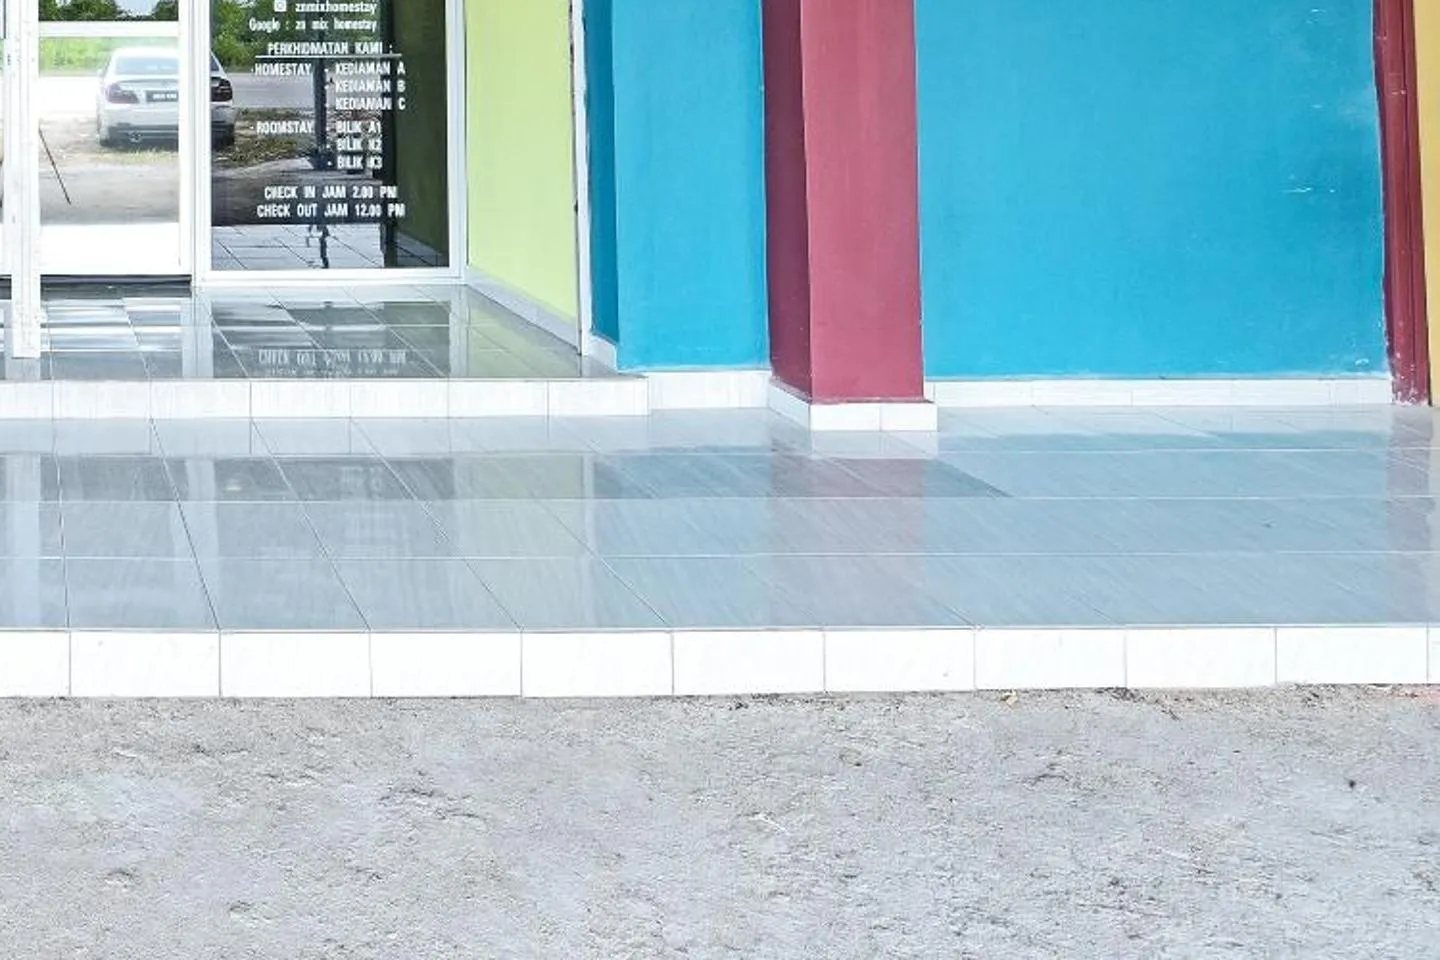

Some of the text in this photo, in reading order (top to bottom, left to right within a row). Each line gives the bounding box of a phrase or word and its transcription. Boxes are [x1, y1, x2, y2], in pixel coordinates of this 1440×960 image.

[248, 17, 281, 33] Google
[334, 17, 378, 33] homestay
[267, 41, 349, 55] PERKHIDMATAN
[355, 41, 383, 54] KAMI
[254, 61, 406, 76] HOMESTAY KEDIAMAN A
[335, 79, 406, 93] KEDIAMAN B
[335, 97, 406, 110] KEDIAMAN C
[256, 121, 382, 134] ROOMSTAY BILIK A1
[337, 138, 363, 152] BILIK
[337, 155, 363, 169] BILIK
[264, 186, 398, 199] CHECK IN JAM 2.00 PM
[256, 203, 406, 217] CHECK OUT JAM 12.00 PM
